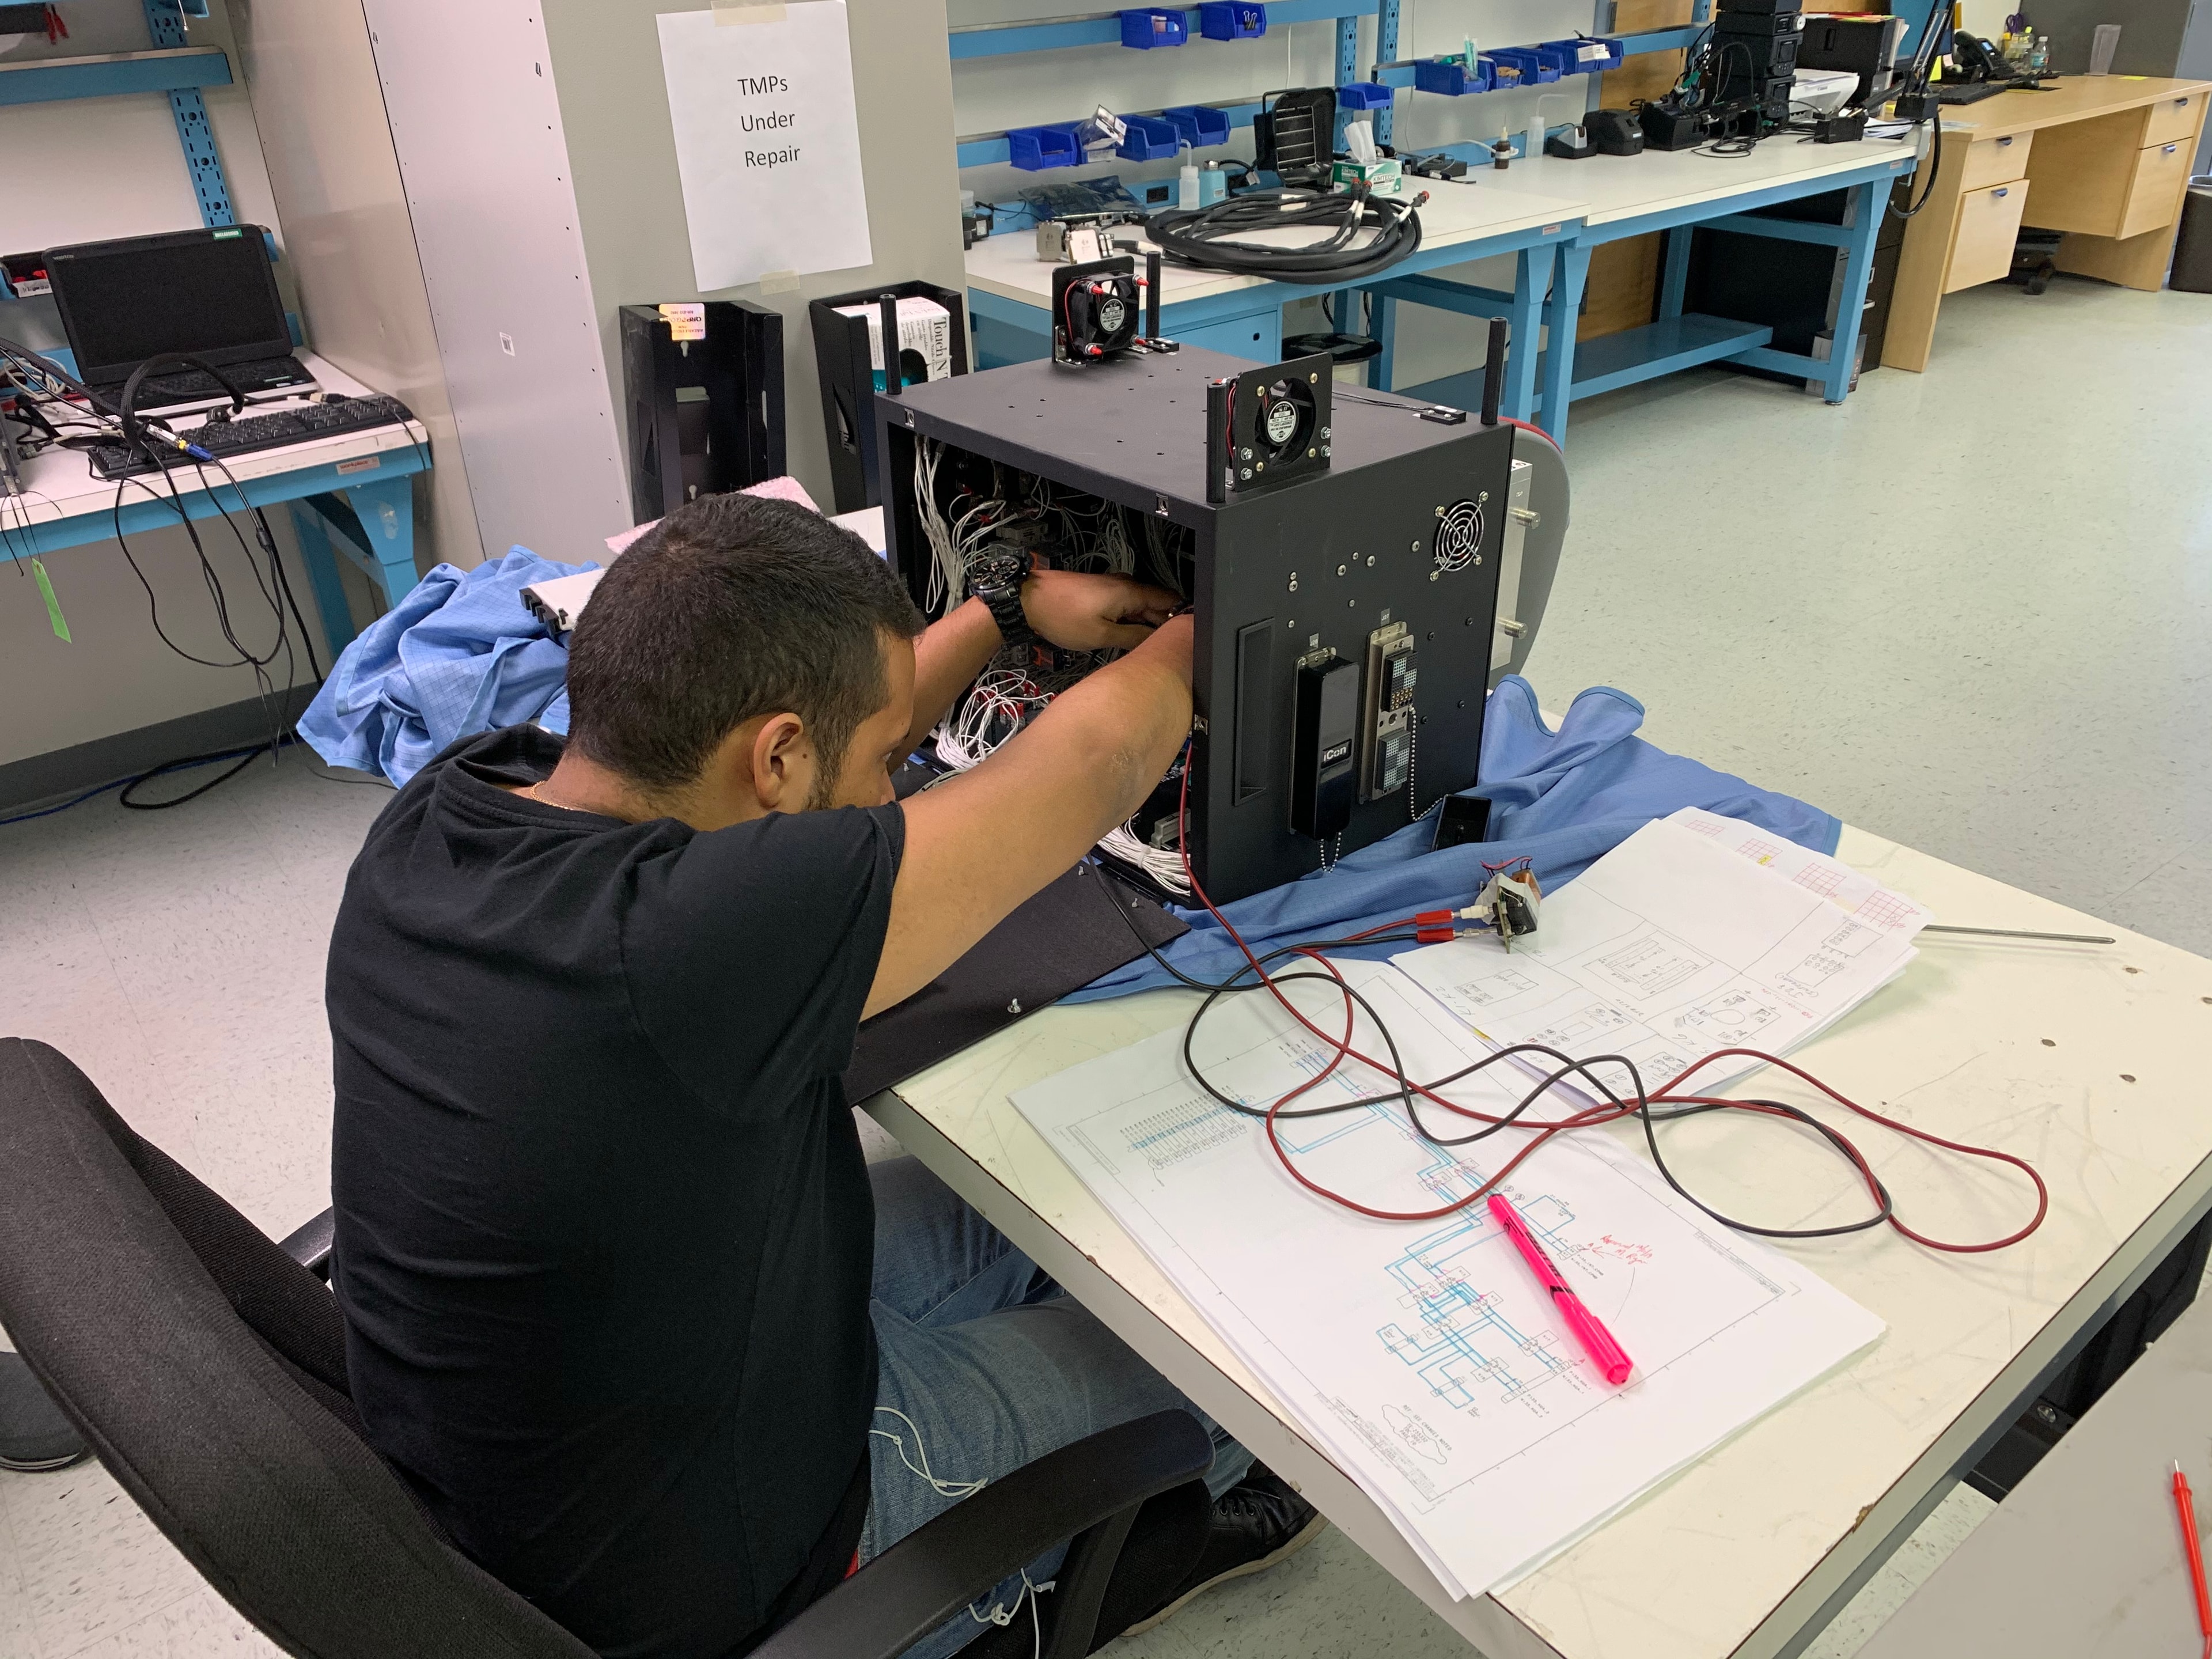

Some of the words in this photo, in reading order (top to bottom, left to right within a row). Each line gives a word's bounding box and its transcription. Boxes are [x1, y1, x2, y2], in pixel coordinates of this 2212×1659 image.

[737, 76, 787, 96] TMPs
[741, 111, 795, 132] Under
[745, 146, 800, 169] Repair
[1373, 174, 1395, 182] KIMTECH
[933, 317, 948, 357] Touch
[1323, 747, 1347, 762] iCon
